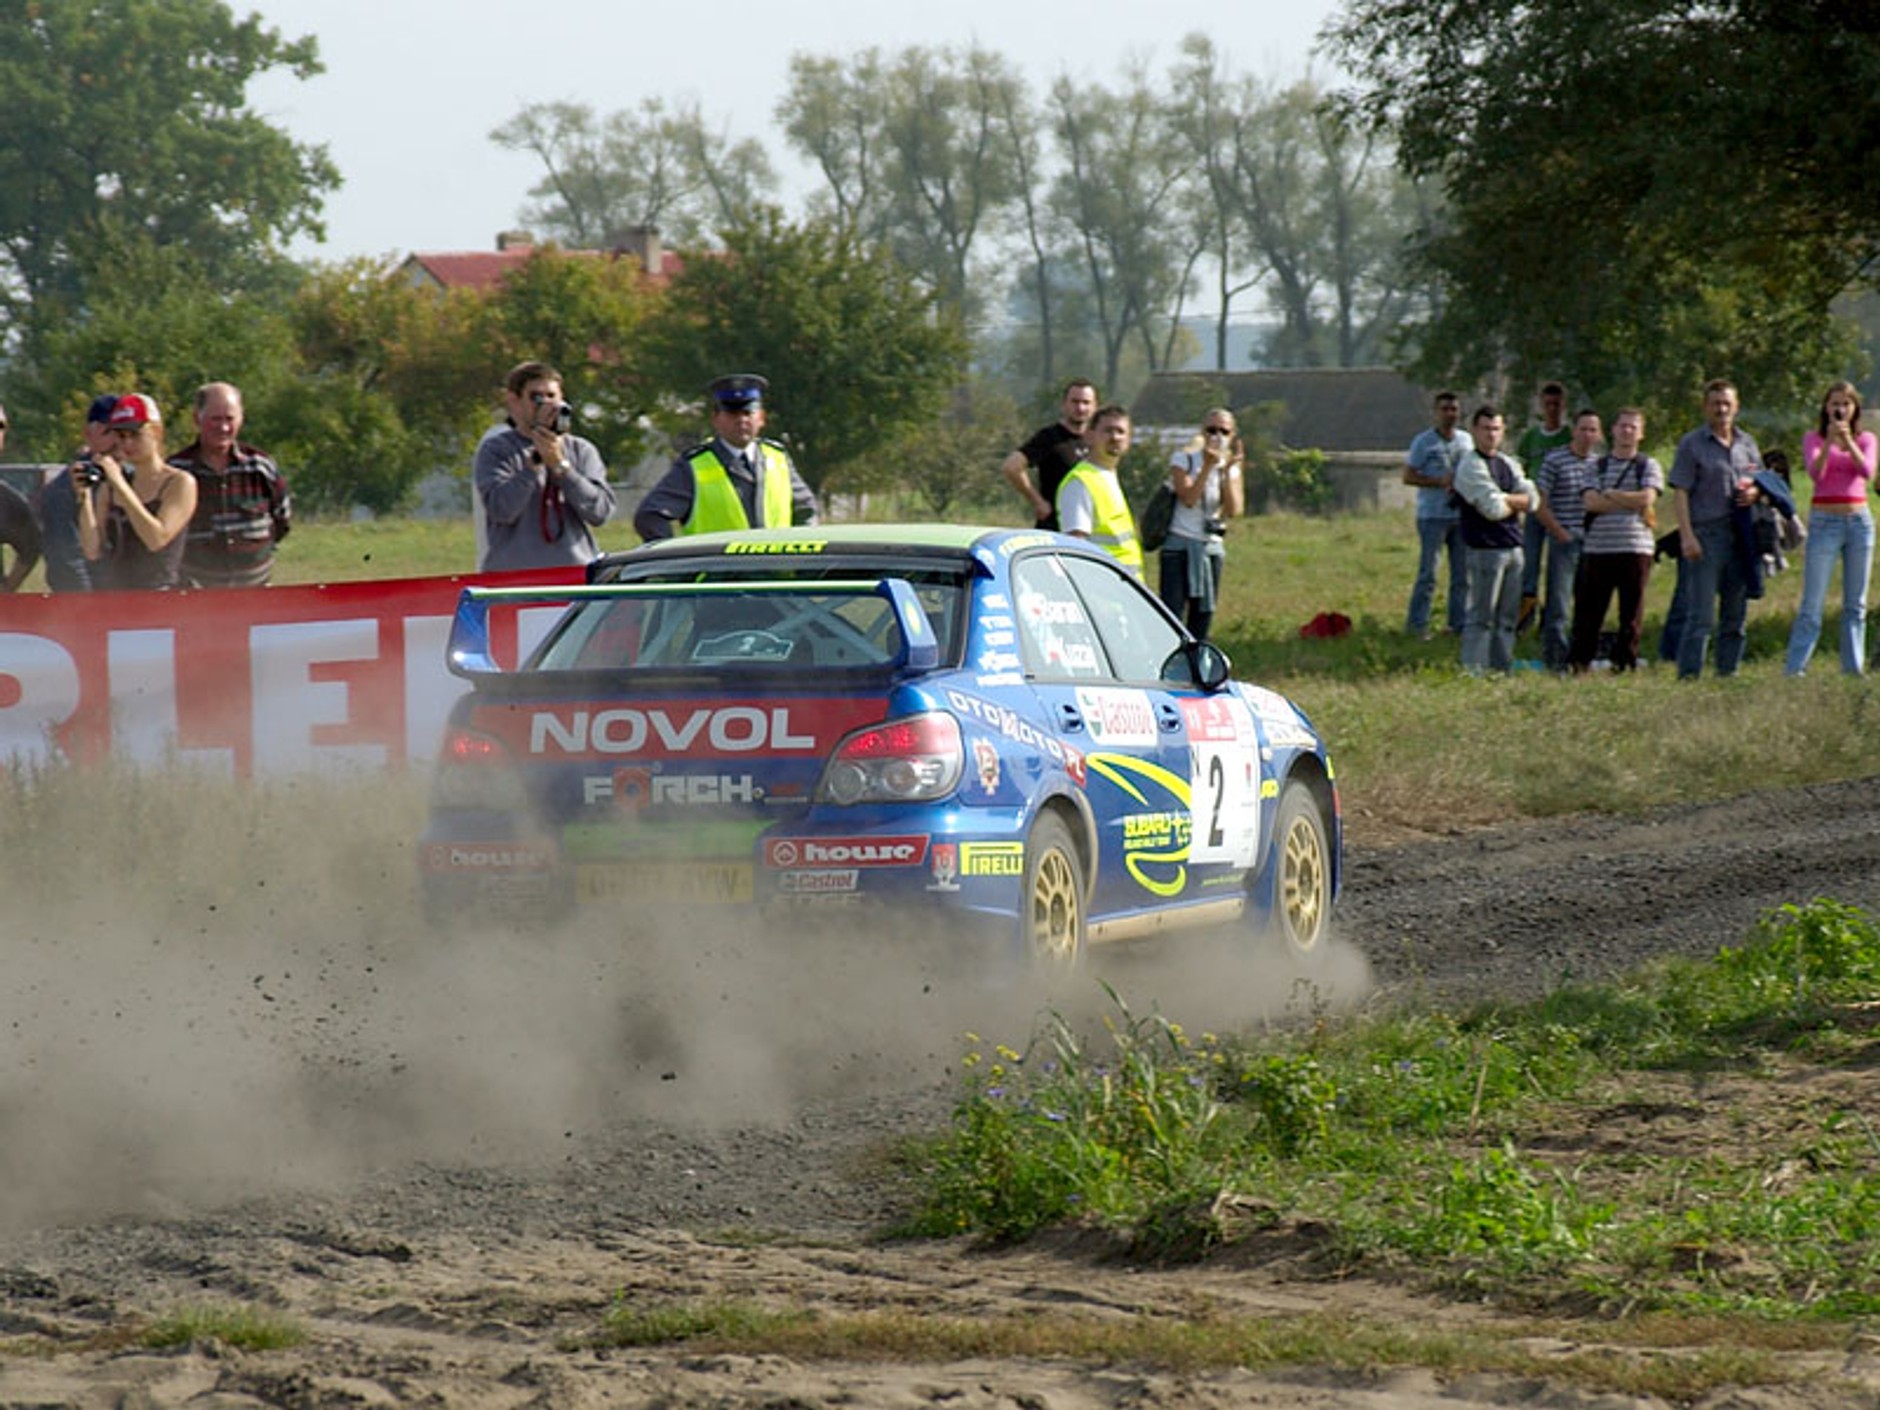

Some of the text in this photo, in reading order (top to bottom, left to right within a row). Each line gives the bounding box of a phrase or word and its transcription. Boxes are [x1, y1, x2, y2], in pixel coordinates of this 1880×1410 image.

[530, 707, 815, 752] NOVOL
[1208, 755, 1224, 847] 2
[959, 842, 1023, 875] PIRELLI
